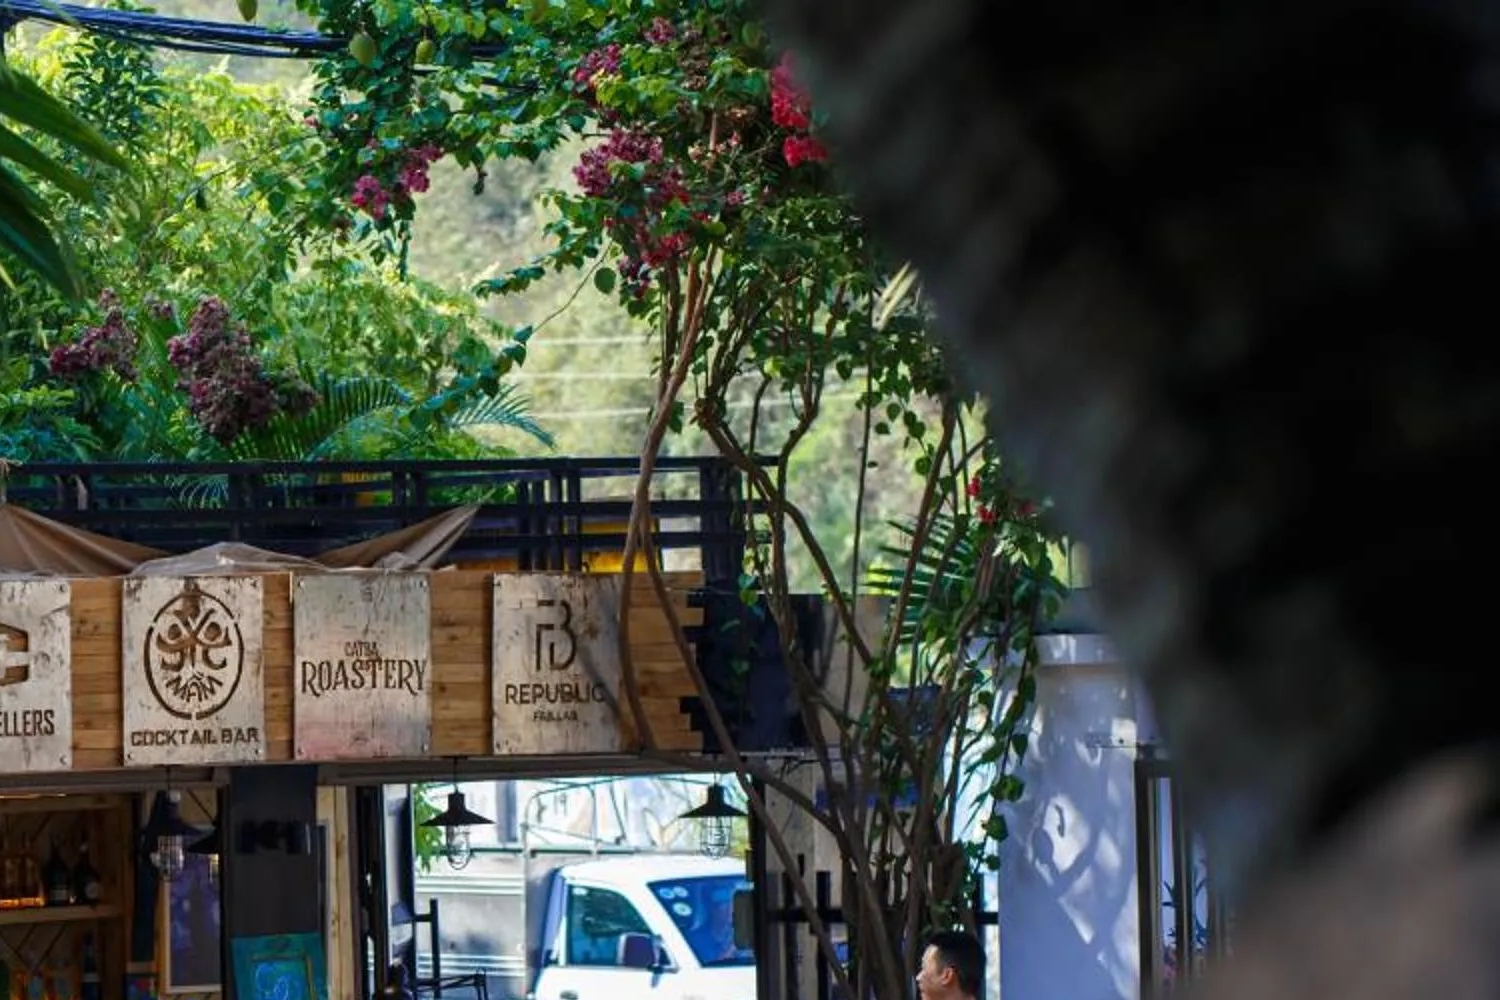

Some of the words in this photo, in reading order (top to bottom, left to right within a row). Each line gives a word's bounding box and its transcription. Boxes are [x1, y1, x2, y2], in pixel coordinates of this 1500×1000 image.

[301, 658, 427, 698] ROASTERY
[505, 682, 607, 705] REPUBLIC
[130, 729, 217, 747] COCKTAIL
[221, 726, 260, 744] BAR
